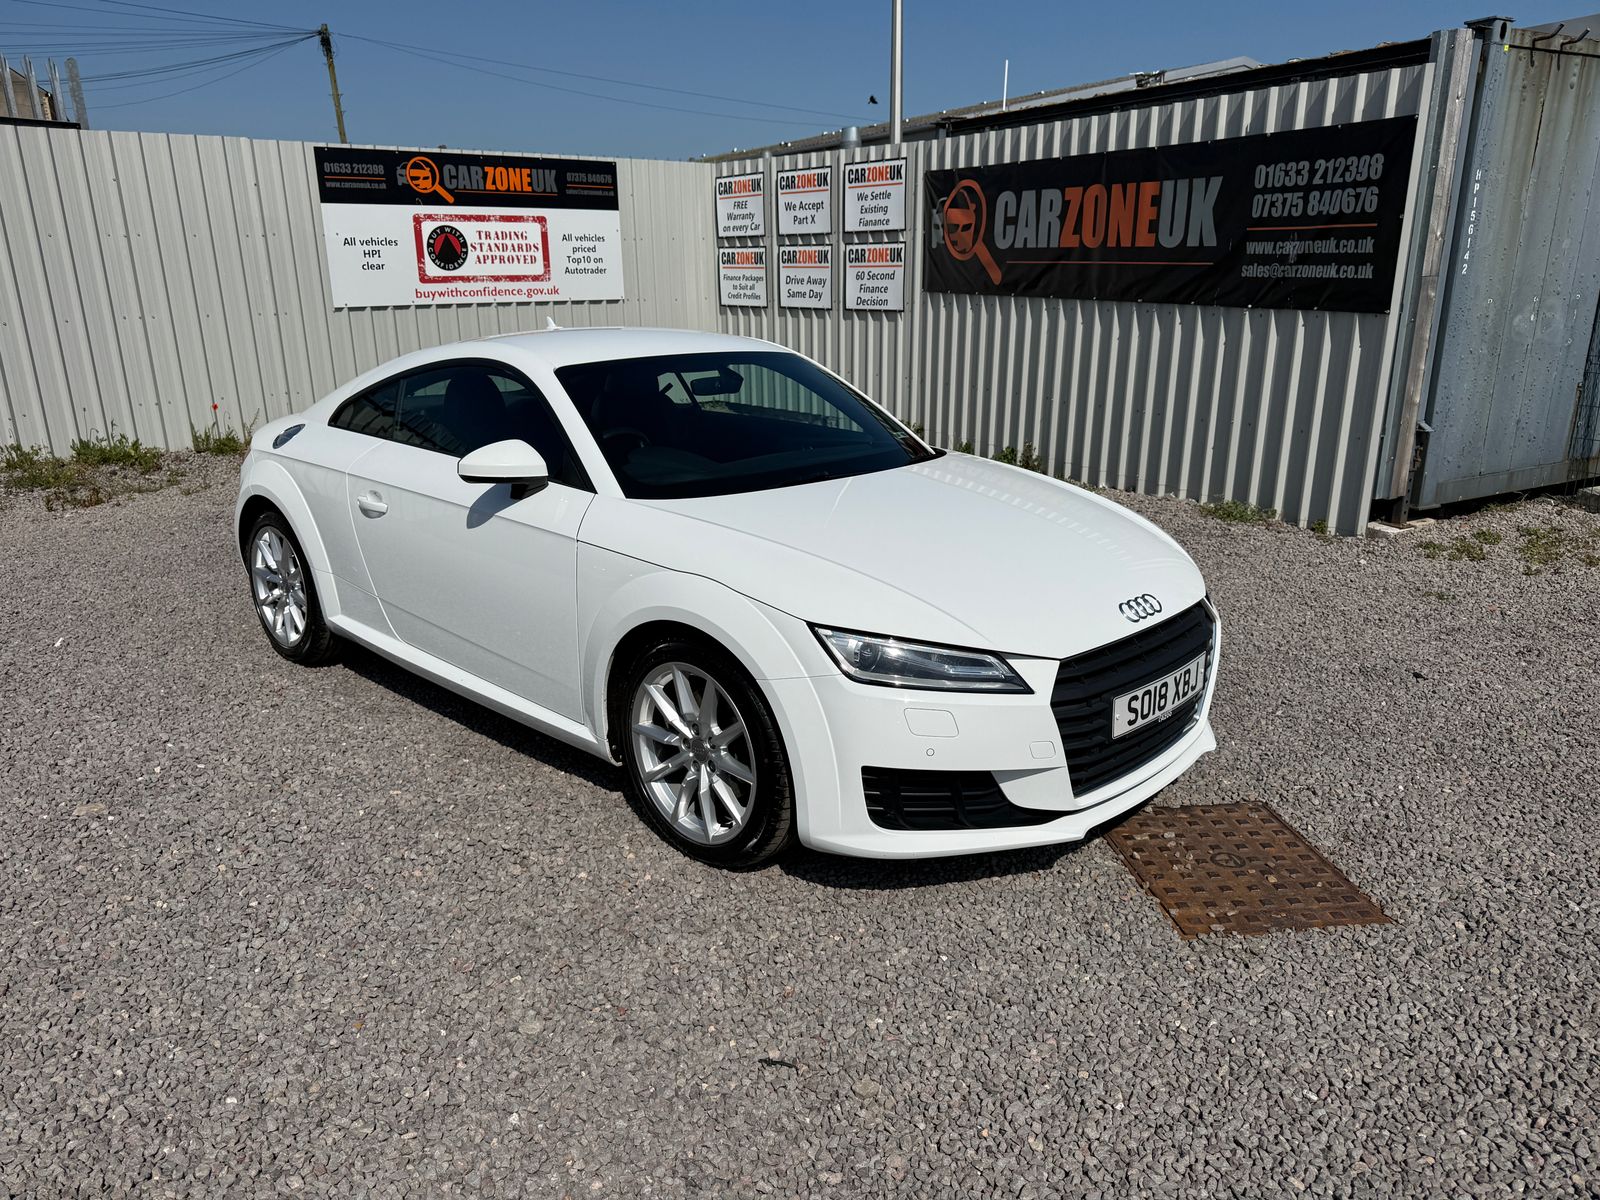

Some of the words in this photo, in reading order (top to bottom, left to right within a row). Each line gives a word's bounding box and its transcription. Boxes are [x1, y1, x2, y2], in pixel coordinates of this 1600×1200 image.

[324, 162, 351, 174] 01633
[353, 163, 385, 175] 212398
[848, 164, 903, 184] CARZONEUK
[1254, 160, 1310, 189] 01633
[1312, 153, 1384, 185] 212398
[442, 164, 558, 193] CARZONEUK
[780, 172, 829, 190] CARZONEUK
[718, 178, 762, 195] CARZONEUK
[857, 192, 869, 202] We
[870, 190, 892, 201] Settle
[1252, 191, 1304, 218] 07375
[1306, 186, 1379, 217] 840676
[733, 200, 748, 210] FREE
[784, 201, 797, 211] We
[798, 200, 824, 212] Accept
[860, 203, 889, 216] Existing
[727, 212, 755, 222] Warranty
[994, 176, 1224, 250] CARZONEUK
[793, 215, 809, 225] Part
[810, 214, 816, 225] X
[859, 218, 890, 227] Fianance
[732, 225, 749, 233] every
[750, 222, 761, 231] Car
[429, 228, 441, 244] BUY
[444, 226, 465, 244] WITH
[476, 230, 528, 241] TRADING
[562, 233, 573, 242] All
[574, 233, 605, 242] vehicles
[343, 237, 356, 246] All
[359, 237, 399, 247] vehicles
[470, 242, 540, 253] STANDARDS
[1246, 237, 1375, 255] www.carzoneuk.co.uk
[363, 249, 381, 258] HPI
[572, 245, 597, 255] priced
[848, 247, 903, 264] CARZONEUK
[428, 247, 468, 270] CONFIDENCE
[475, 254, 537, 265] APPROVED
[566, 255, 592, 266] Top10
[721, 251, 764, 265] CARZONEUK
[781, 249, 829, 264] CARZONEUK
[362, 261, 385, 271] clear
[565, 266, 608, 275] Autotrader
[1241, 262, 1374, 279] sales@carzoneuk.co.uk
[742, 274, 764, 283] Packages
[855, 270, 866, 281] 60
[867, 269, 896, 281] Second
[785, 275, 805, 285] Drive
[806, 275, 828, 289] Away
[415, 286, 560, 301] buywithconfidence.gov.uk
[859, 283, 889, 294] Finance
[727, 292, 742, 300] Credit
[743, 292, 761, 300] Profiles
[787, 289, 807, 299] Same
[808, 289, 824, 301] Day
[856, 296, 888, 306] Decision
[1127, 681, 1169, 727] SO18
[1171, 661, 1200, 705] XBJ
